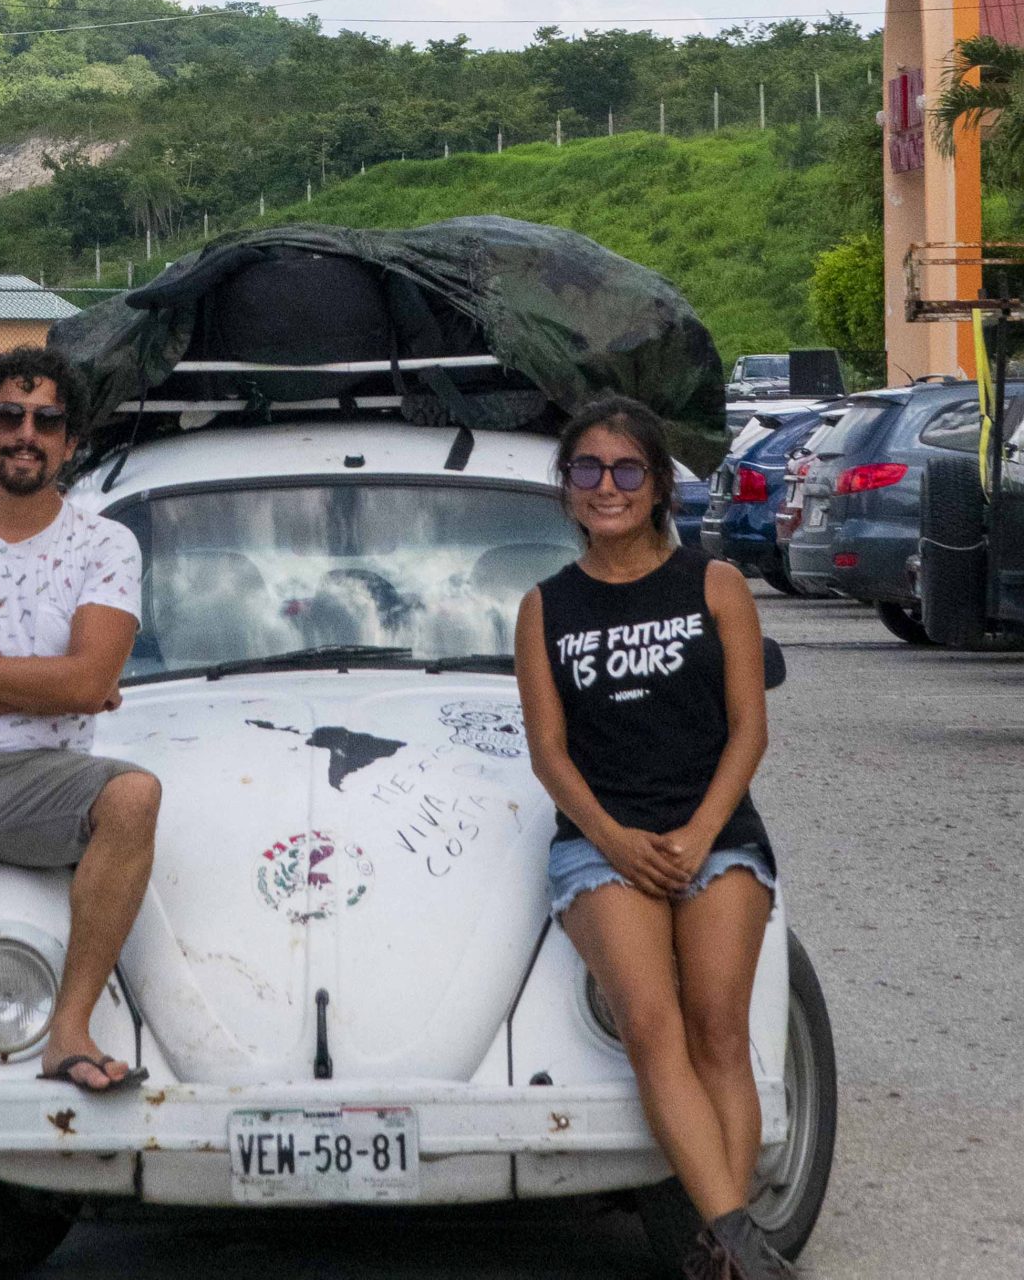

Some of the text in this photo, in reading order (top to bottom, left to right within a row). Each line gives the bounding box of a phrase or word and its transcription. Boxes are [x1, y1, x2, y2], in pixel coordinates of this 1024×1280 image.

[556, 612, 704, 665] THE FUTURE
[572, 640, 684, 691] IS OURS
[395, 793, 447, 855] VIVA
